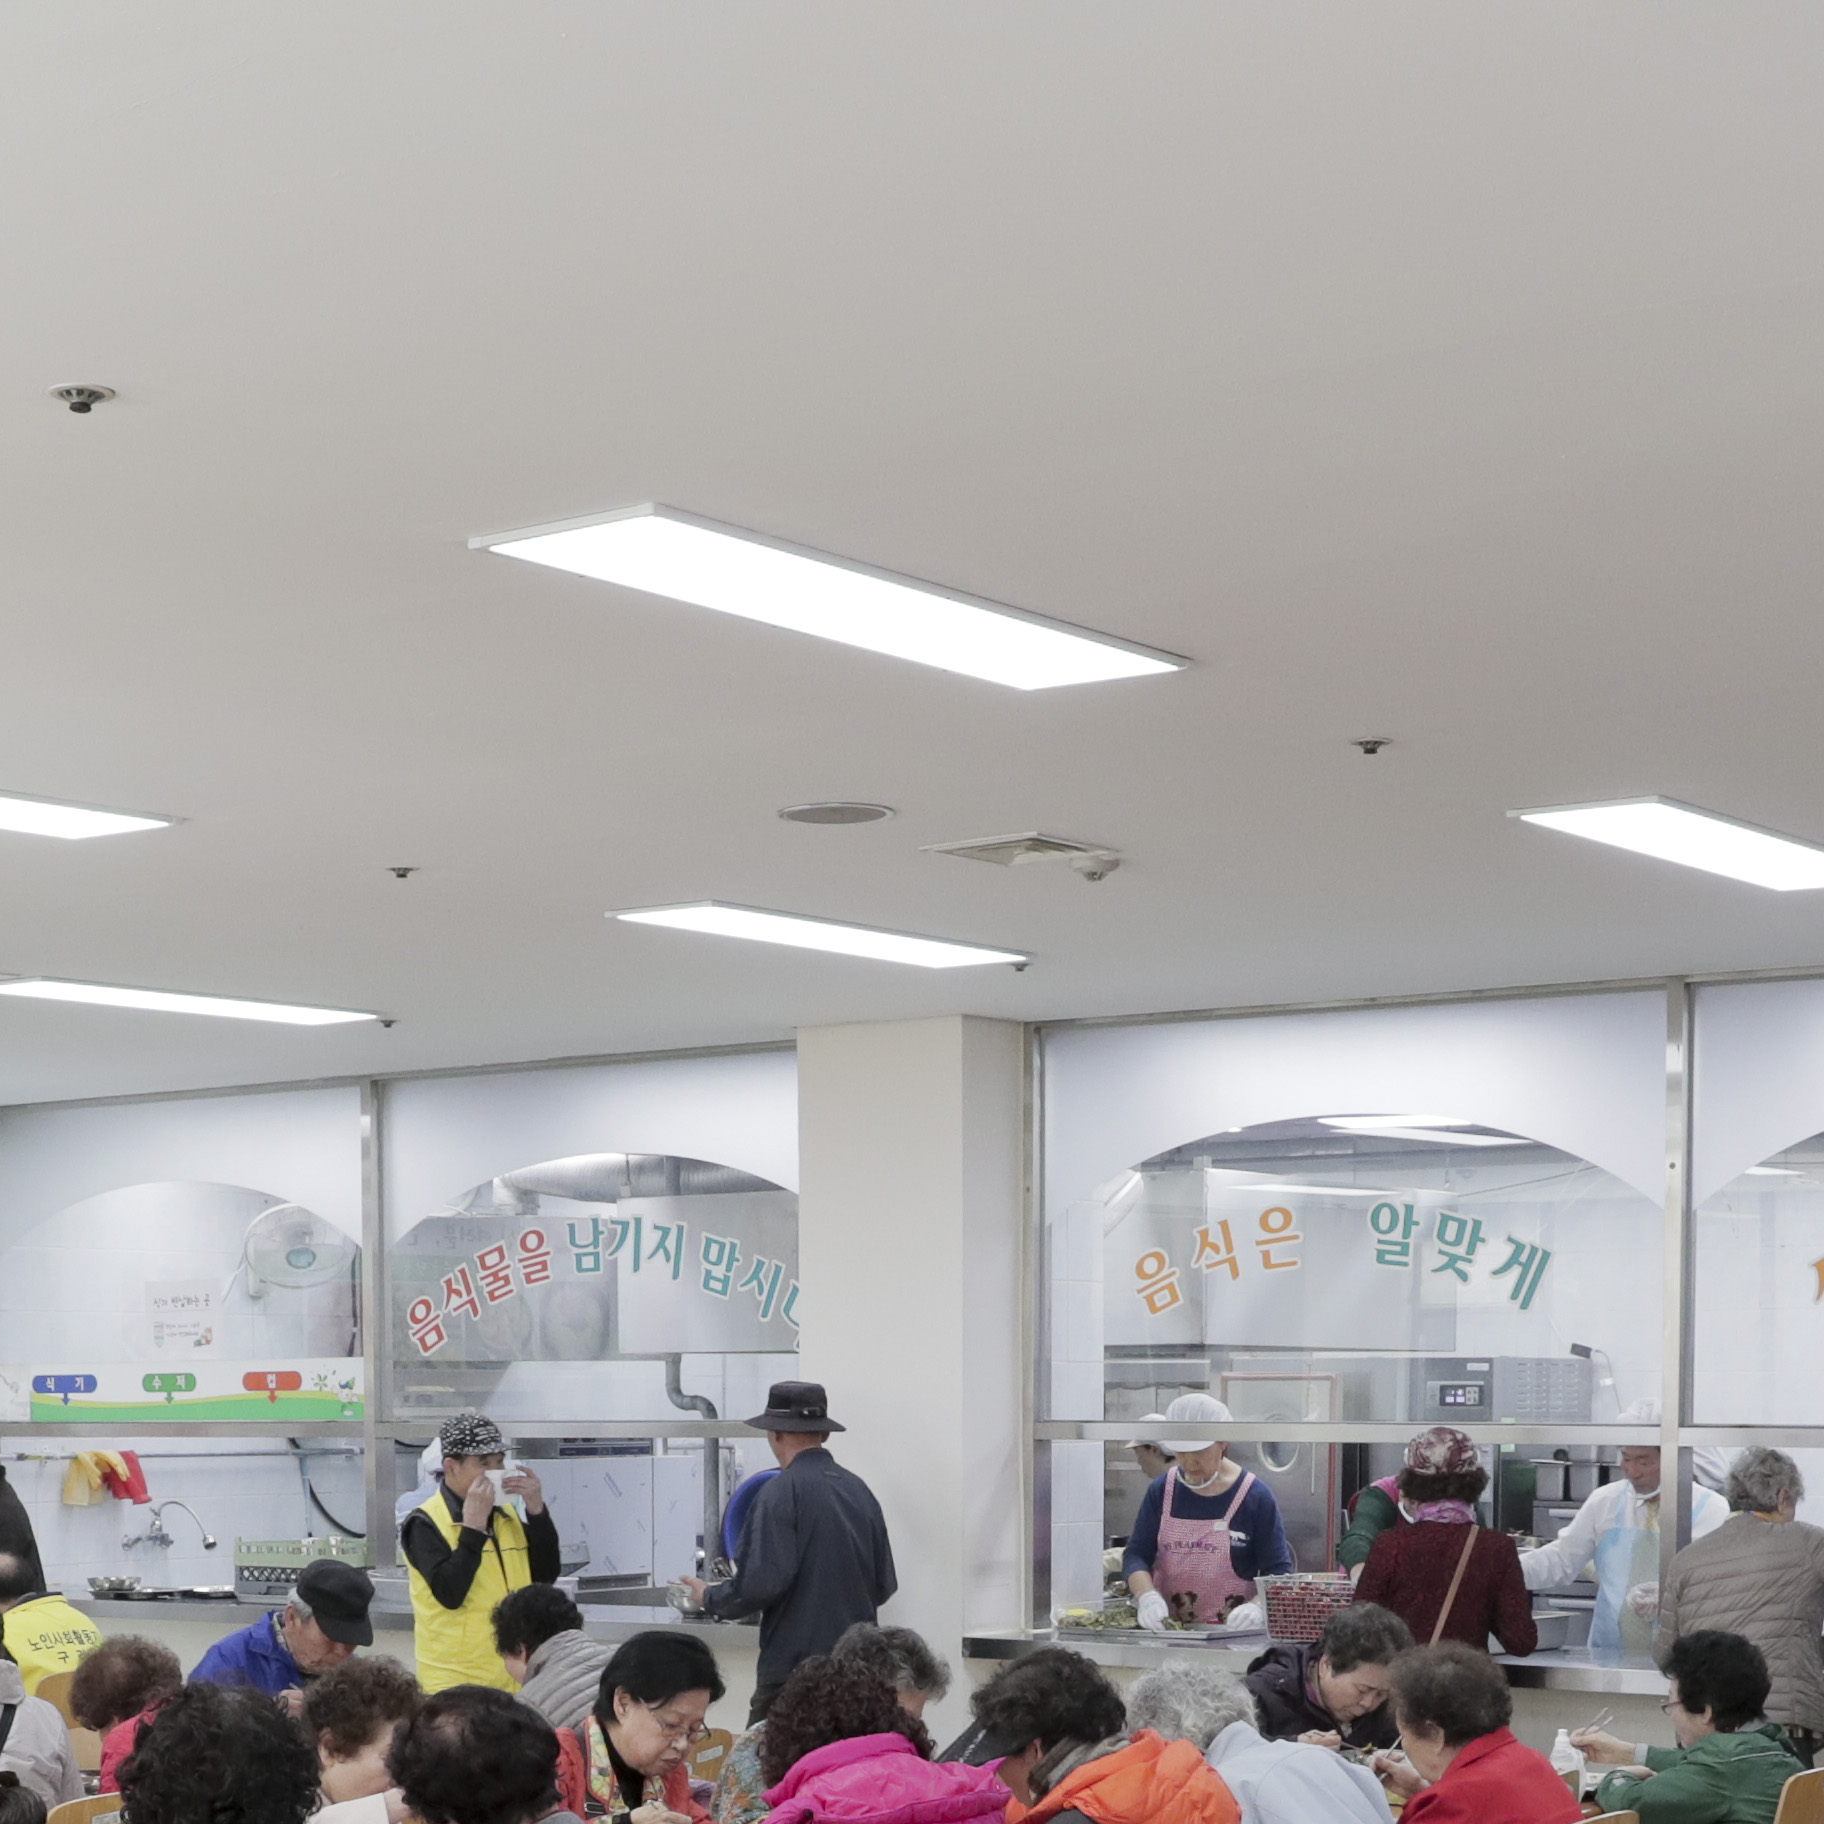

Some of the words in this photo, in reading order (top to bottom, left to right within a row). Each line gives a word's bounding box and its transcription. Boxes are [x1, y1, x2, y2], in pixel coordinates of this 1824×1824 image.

[408, 1230, 551, 1354] 음식물을
[567, 1215, 685, 1280] 남기지
[1134, 1206, 1301, 1314] 음식은
[1370, 1203, 1552, 1309] 알맞게
